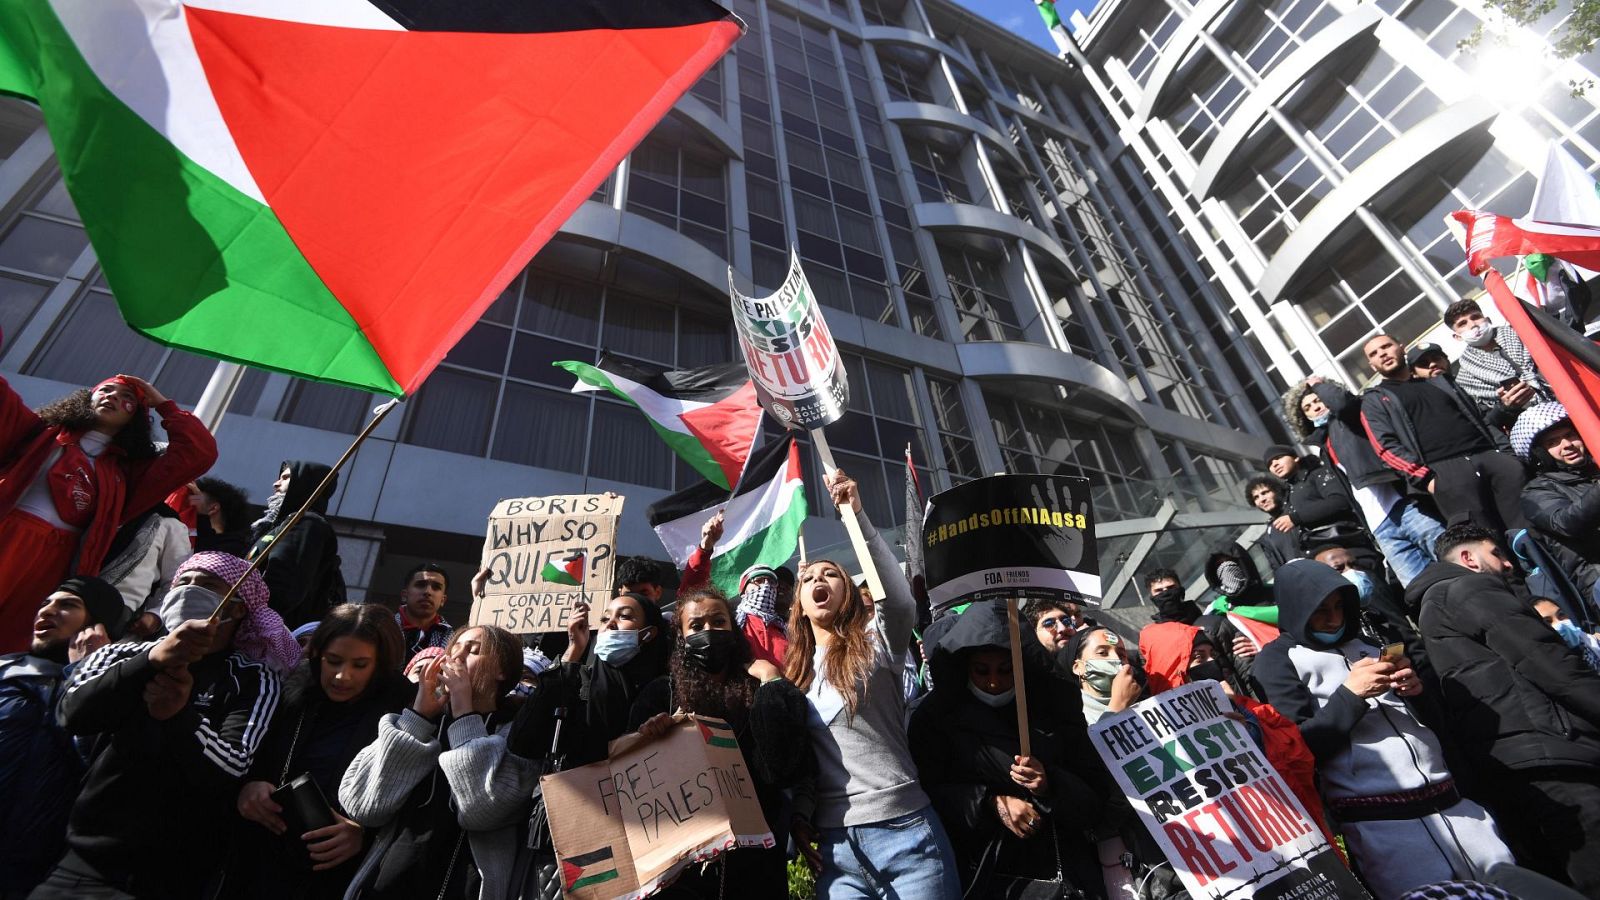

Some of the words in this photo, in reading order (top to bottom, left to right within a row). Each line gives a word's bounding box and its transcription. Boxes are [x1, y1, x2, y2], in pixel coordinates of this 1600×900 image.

[507, 497, 609, 516] BORIS,
[493, 520, 549, 549] WHY
[560, 519, 598, 541] SO
[927, 507, 1087, 548] #HandsOffAlAqsa
[984, 571, 1003, 586] FOA
[491, 606, 572, 630] ISRAE
[508, 592, 594, 608] CONDEMN
[1100, 716, 1153, 761] FREE
[1141, 686, 1224, 739] PALESTINE
[1121, 719, 1249, 796] EXIST!
[598, 751, 665, 816] FREE
[637, 764, 752, 843] PALESTINE
[1144, 750, 1270, 824] RESIST!
[1163, 775, 1313, 887] RETURN!
